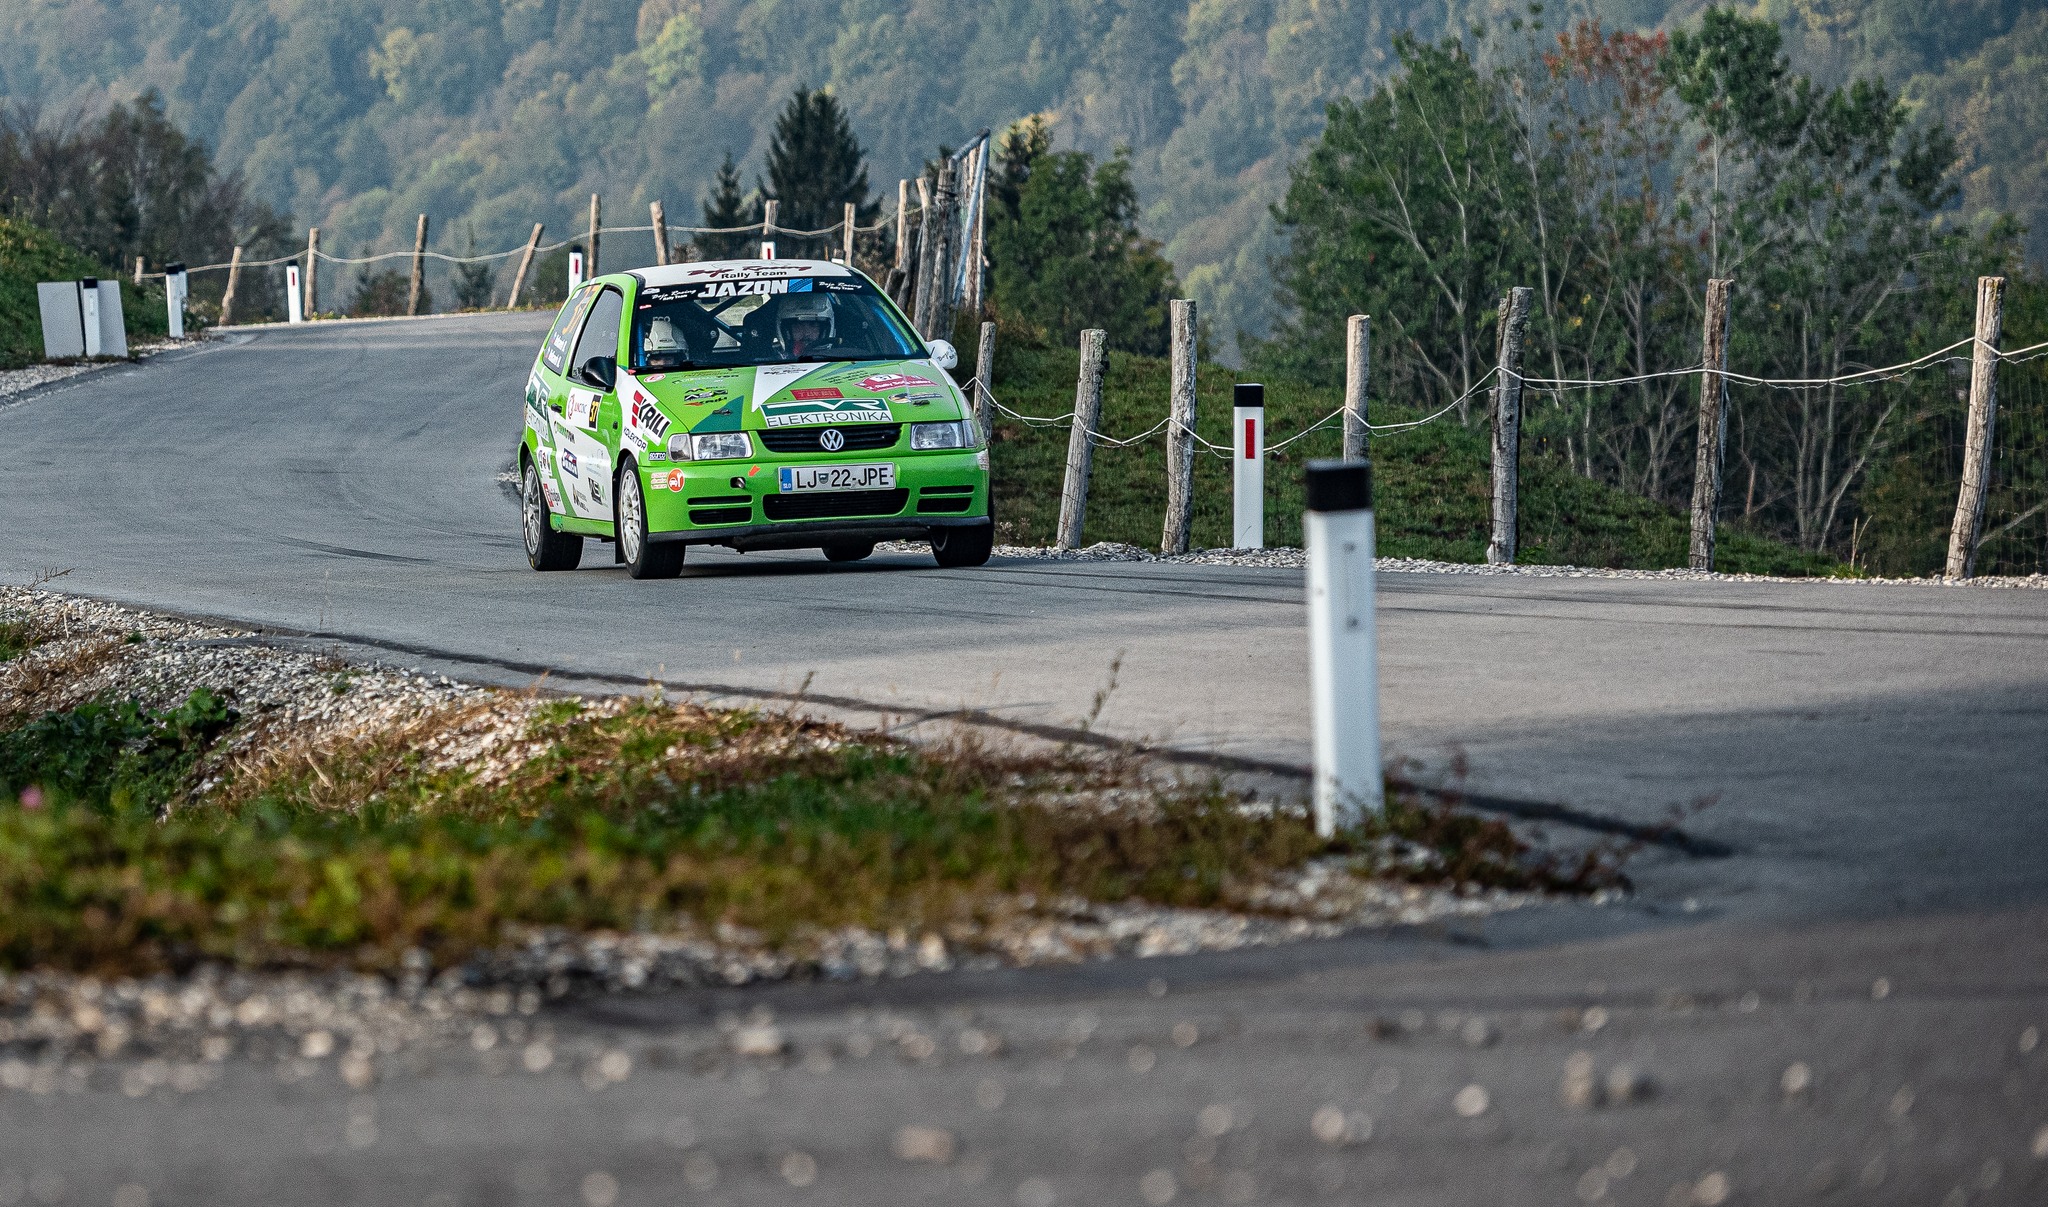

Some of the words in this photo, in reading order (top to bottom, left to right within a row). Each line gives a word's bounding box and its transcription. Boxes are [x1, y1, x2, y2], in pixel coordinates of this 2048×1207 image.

[697, 279, 789, 298] JAZON
[589, 400, 600, 422] 37
[766, 411, 892, 428] ELEKTRONIKA
[623, 426, 647, 451] KOLEKTOR
[830, 467, 889, 488] 22-JPE
